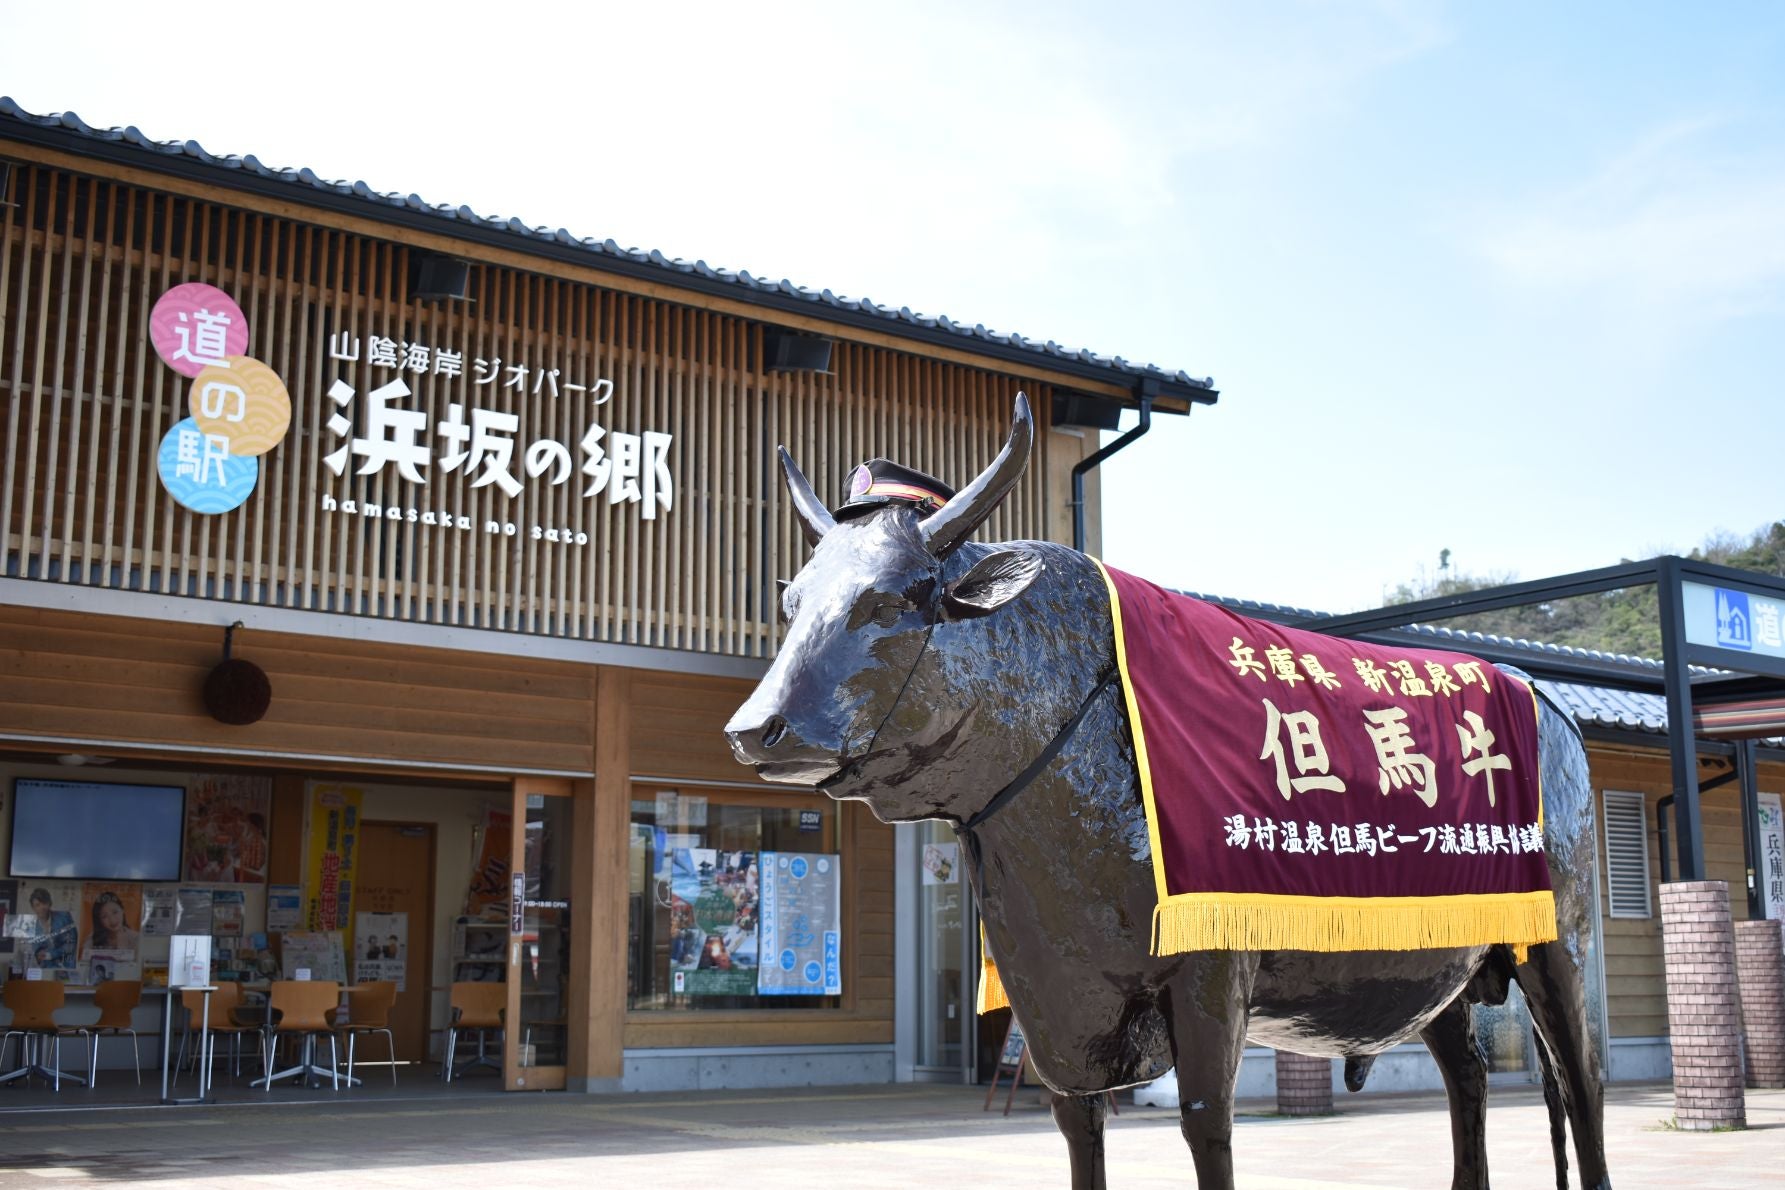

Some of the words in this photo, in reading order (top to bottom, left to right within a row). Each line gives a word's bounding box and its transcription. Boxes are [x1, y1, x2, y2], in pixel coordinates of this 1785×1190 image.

[172, 308, 246, 488] 道の駅
[329, 330, 463, 378] 山陰海岸
[473, 357, 614, 405] ジオパーク
[322, 377, 673, 520] 浜坂の郷
[322, 494, 471, 531] hamasaka
[486, 518, 516, 537] no
[531, 525, 588, 546] sato
[1754, 602, 1785, 648] 道
[1228, 636, 1342, 691] 兵庫県
[1351, 656, 1491, 697] 新温泉町
[1259, 697, 1512, 808] 但馬牛
[1767, 833, 1784, 902] 兵庫県
